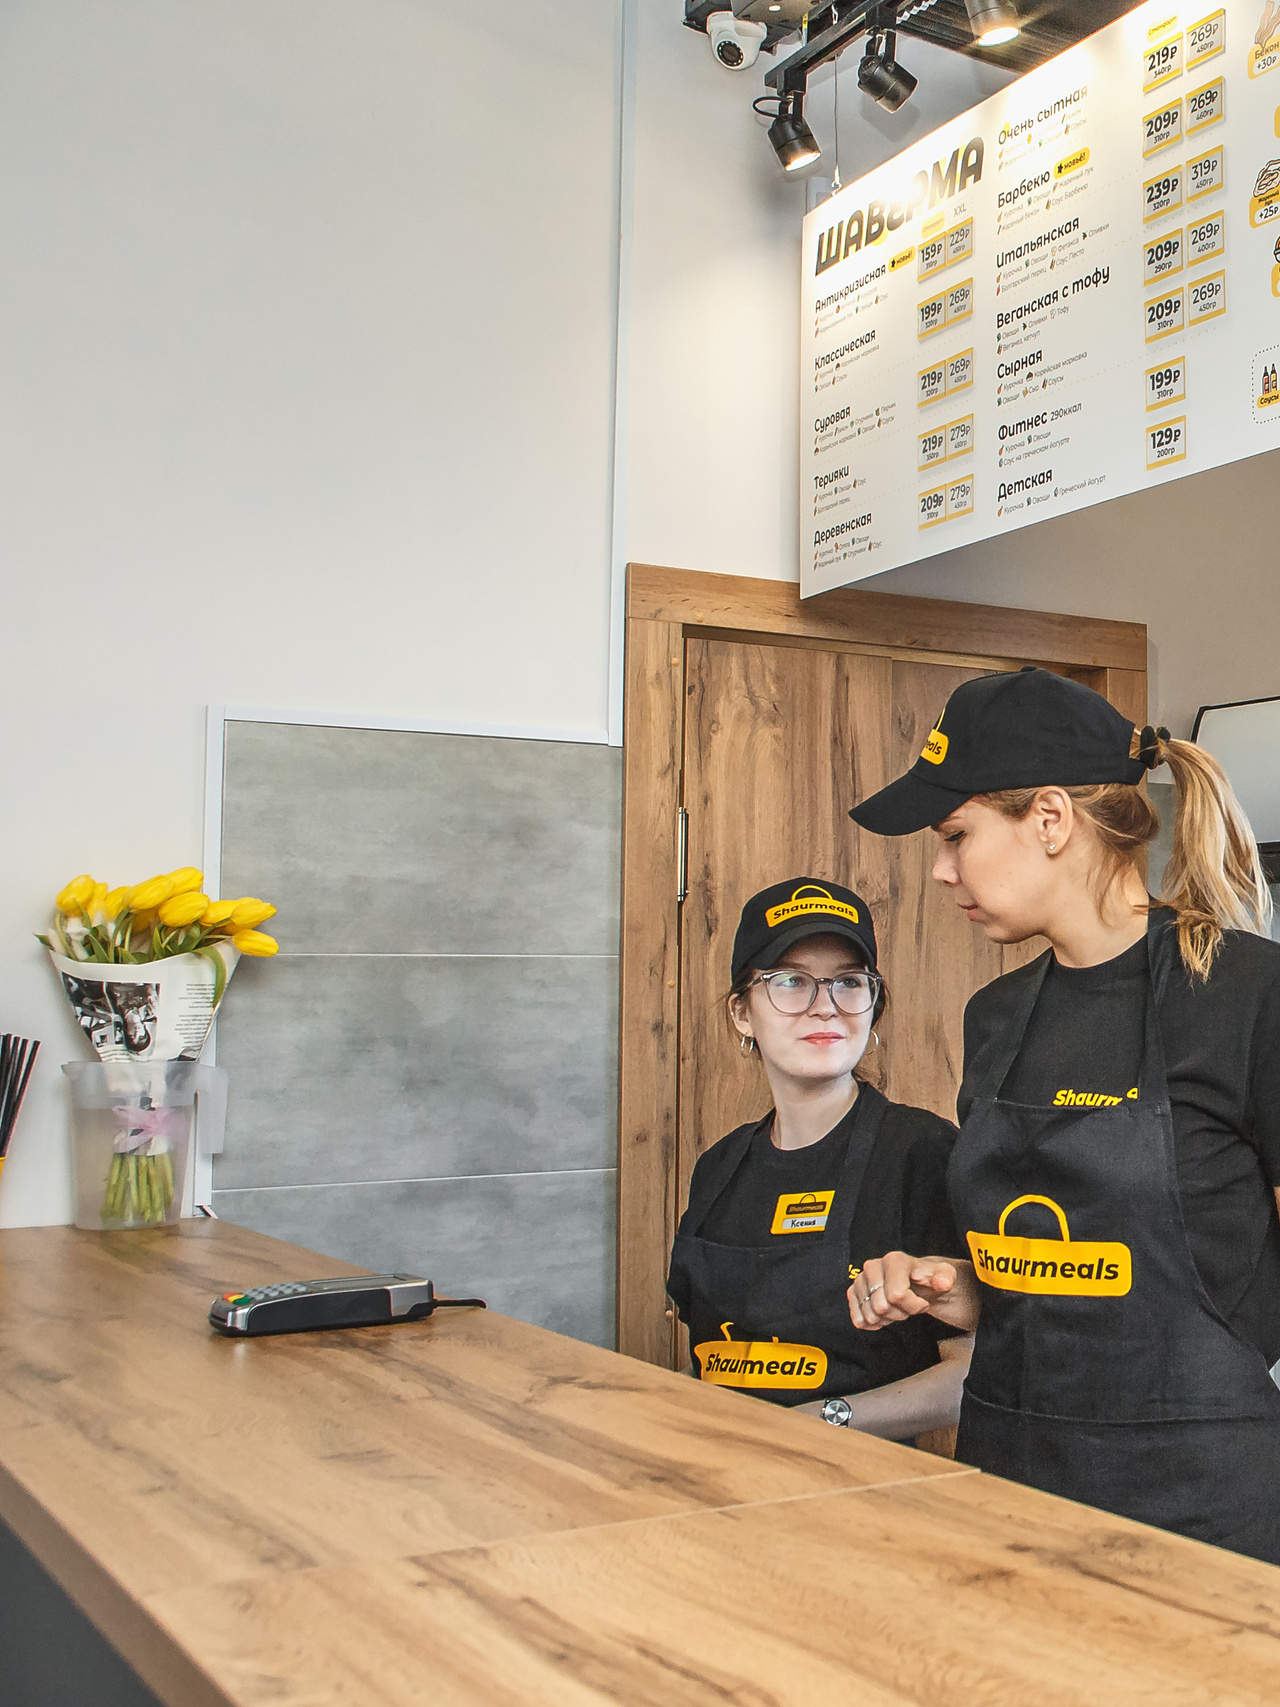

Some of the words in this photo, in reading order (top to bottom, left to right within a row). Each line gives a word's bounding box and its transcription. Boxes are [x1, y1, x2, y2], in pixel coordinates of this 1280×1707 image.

[1254, 41, 1280, 60] Бекон
[998, 119, 1034, 145] Очень
[1037, 85, 1088, 123] сытная
[998, 171, 1050, 208] Барбекю
[996, 217, 1080, 268] Итальянская
[815, 264, 887, 313] Антикризисная
[996, 290, 1059, 329] Веганская
[1061, 285, 1069, 299] с
[1072, 266, 1110, 294] тофу
[815, 330, 876, 370] Классическая
[997, 350, 1043, 379] Сырная
[1259, 393, 1280, 406] Соусы
[814, 406, 851, 433] Суровая
[998, 411, 1048, 440] Фитнес
[1050, 402, 1082, 422] 290ккал
[814, 465, 850, 489] Терияки
[997, 469, 1053, 502] Детская
[814, 513, 872, 547] Деревенская
[773, 903, 855, 920] Shaurmeals
[977, 1247, 1120, 1281] Shaurmeals
